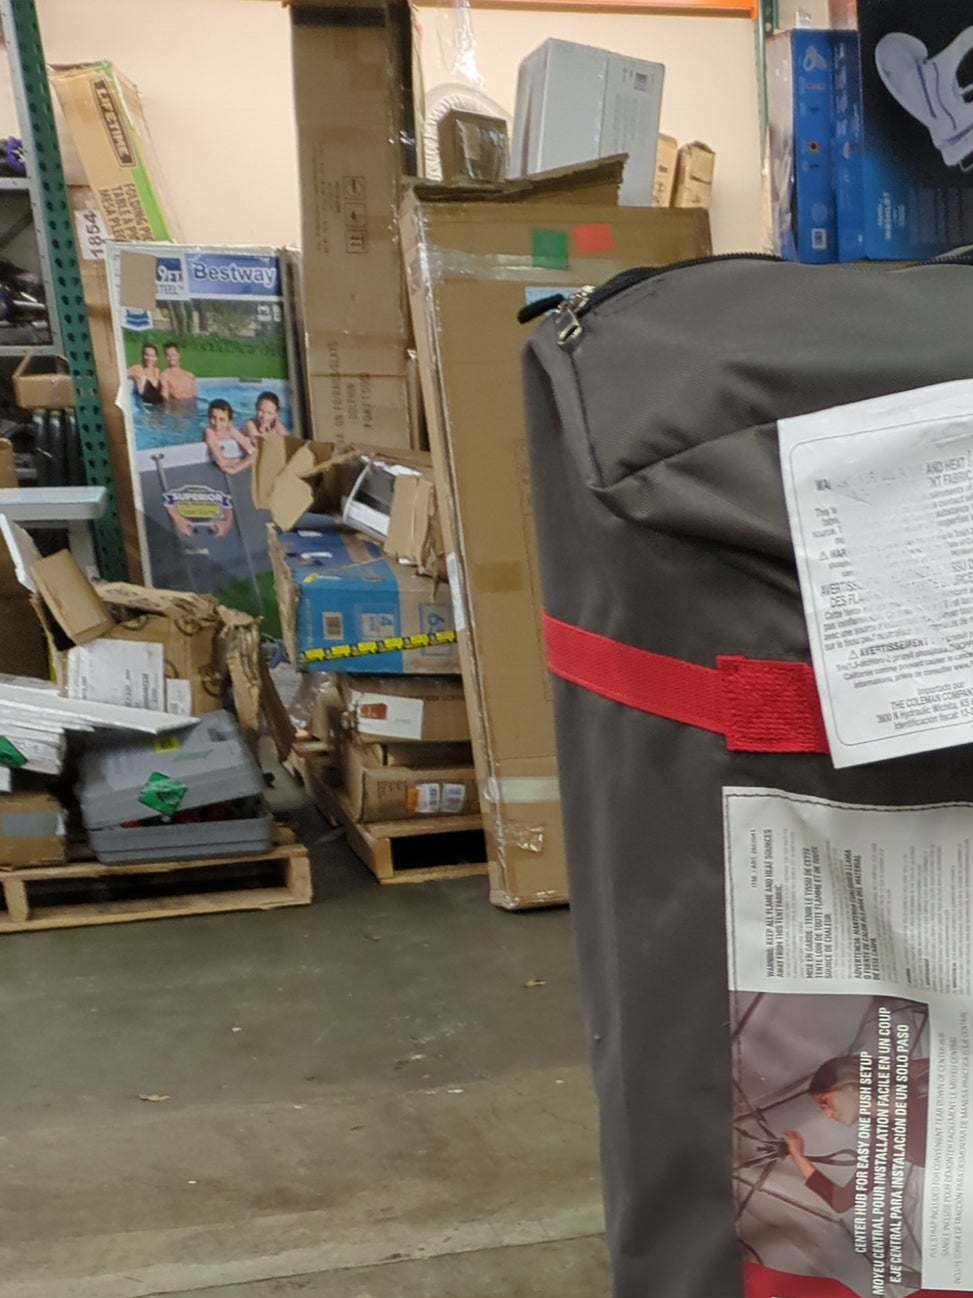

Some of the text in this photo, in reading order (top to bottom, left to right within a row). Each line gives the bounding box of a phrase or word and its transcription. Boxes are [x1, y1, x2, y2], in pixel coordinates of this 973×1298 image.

[97, 90, 130, 157] LIFETIME
[100, 189, 116, 216] MESA
[112, 186, 131, 217] TABLE
[125, 183, 149, 226] FOLDING
[84, 211, 103, 258] 1854
[193, 262, 276, 288] Bestway
[926, 460, 943, 474] AND
[764, 861, 773, 877] HEAT
[765, 879, 773, 892] AND
[765, 894, 774, 914] FLAME
[766, 916, 774, 927] ALL
[775, 908, 783, 924] TENT
[775, 925, 783, 939] THIS
[775, 941, 784, 959] FROM
[775, 960, 784, 978] AWAY
[855, 1051, 873, 1253] CENTER HUB FOR EASY ONE PUSH SETUP
[872, 1007, 892, 1295] MOYEU CENTRAL POUR INSTALLATION FACILE EN UN COUP
[890, 1024, 910, 1283] EJE CENTRAL PARA INSTALACIÓN DE UN SOLO PASO
